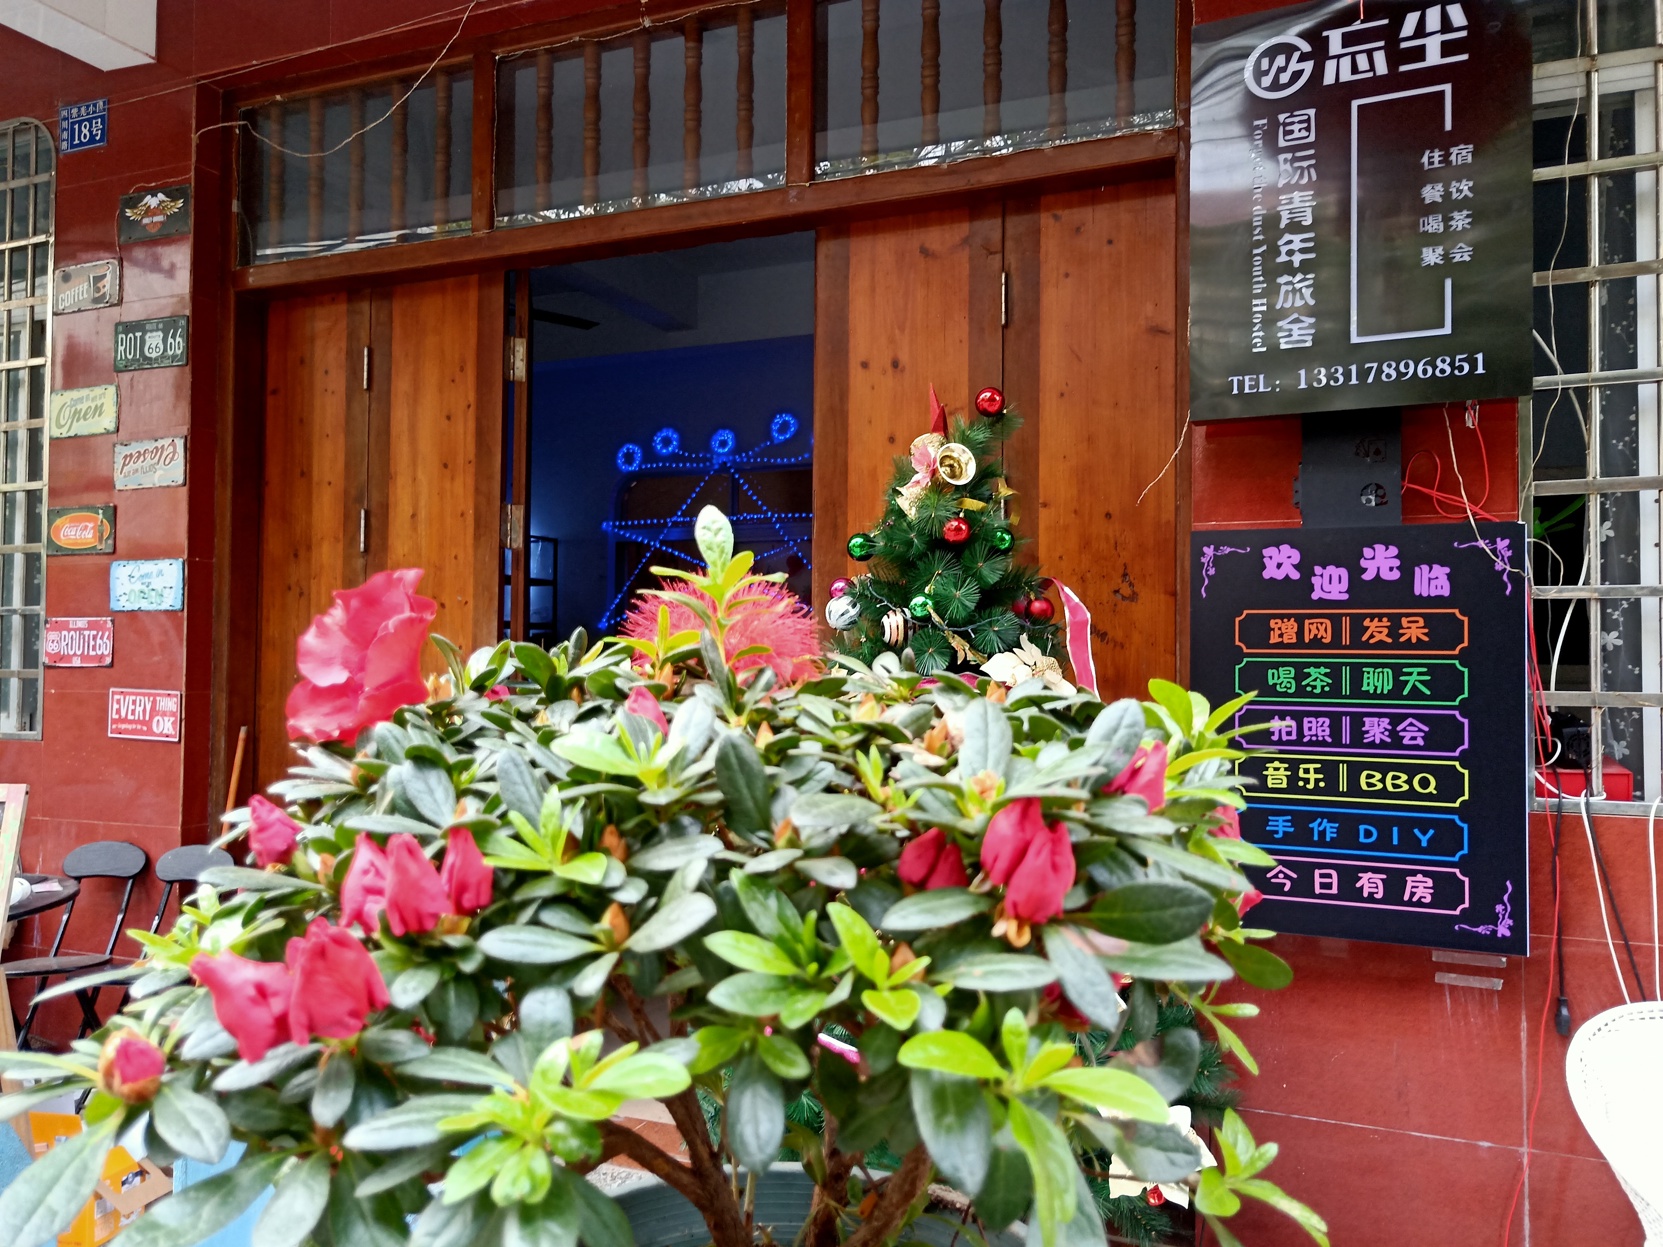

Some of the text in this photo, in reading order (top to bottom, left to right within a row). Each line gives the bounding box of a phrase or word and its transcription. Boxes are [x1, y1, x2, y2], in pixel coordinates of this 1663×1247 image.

[1322, 3, 1469, 86] 忘尘
[73, 118, 102, 144] 18号
[1420, 144, 1474, 170] 住宿
[1421, 179, 1474, 204] 餐饮
[1252, 205, 1267, 240] dust
[1275, 108, 1316, 350] 国际青年旅舍
[1419, 209, 1473, 234] 喝茶
[1252, 244, 1267, 293] Youth
[1420, 242, 1474, 267] 聚会
[59, 282, 88, 309] COFFEE
[1252, 298, 1267, 353] Hostel
[117, 328, 183, 360] ROT 66 66
[1297, 352, 1487, 389] 13317896851
[55, 401, 105, 434] Open
[120, 440, 179, 475] Closed
[1262, 544, 1451, 600] 欢迎光临
[1269, 616, 1430, 644] 蹭网 发呆
[1267, 665, 1431, 695] 喝茶 聊天
[112, 694, 178, 721] EVERY THING
[152, 715, 176, 735] OK
[1269, 715, 1430, 746] 拍照 聚会
[1262, 761, 1437, 795] 音乐 BBQ
[1265, 815, 1340, 842] 手作
[1266, 865, 1434, 904] 今日有房
